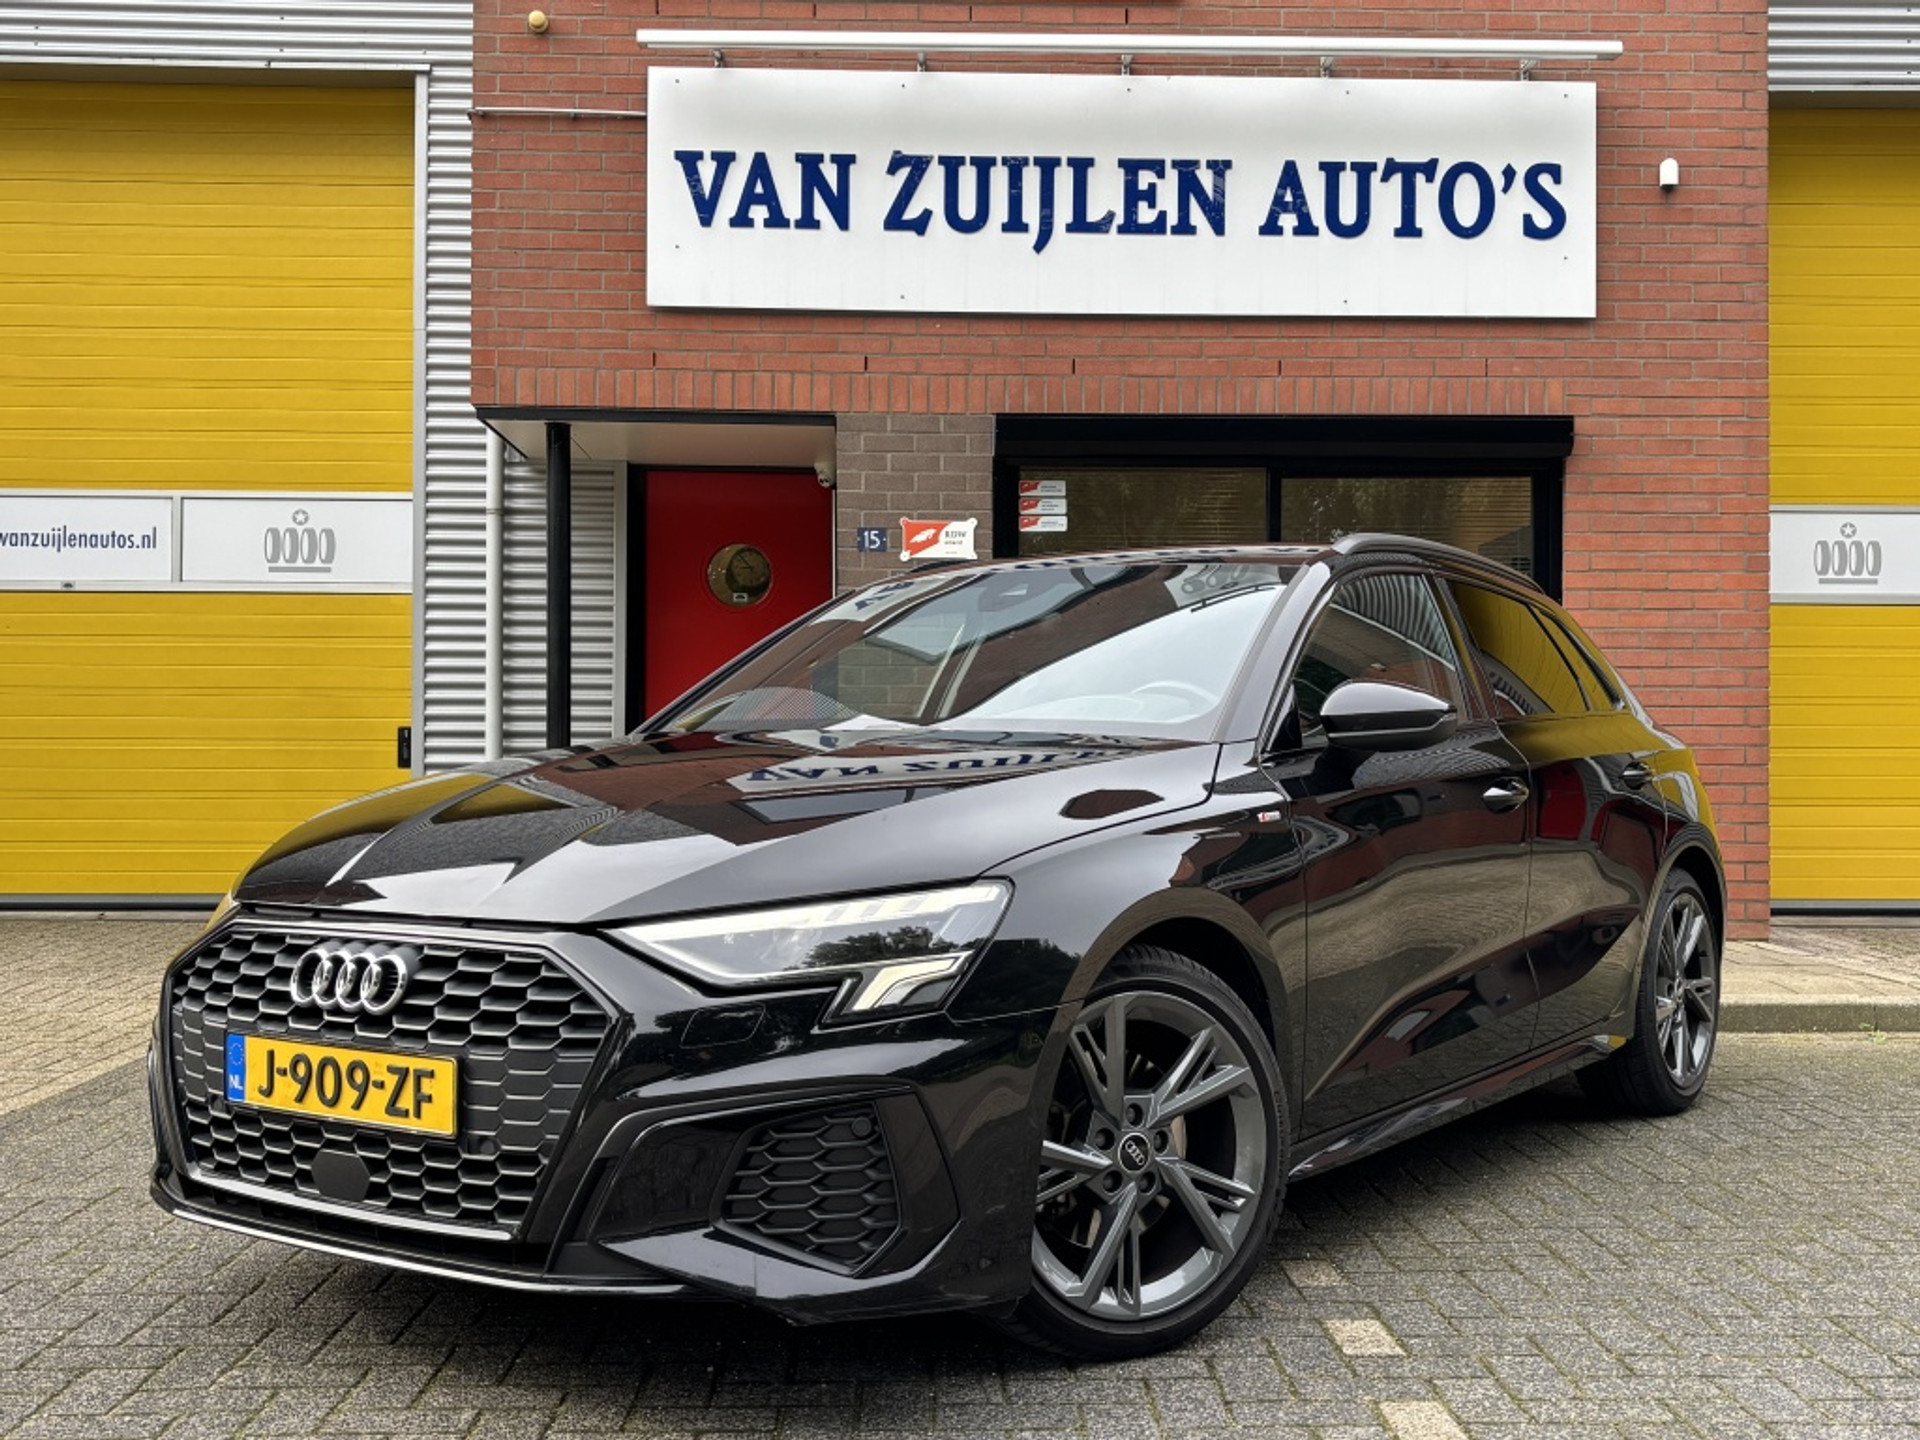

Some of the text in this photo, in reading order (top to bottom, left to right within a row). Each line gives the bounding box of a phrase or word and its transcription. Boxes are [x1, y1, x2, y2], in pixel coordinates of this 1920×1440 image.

[674, 150, 1568, 255] VAN ZUIJLEN AUTO'S
[863, 530, 881, 549] 15
[228, 1049, 435, 1120] NL J-909-ZF
